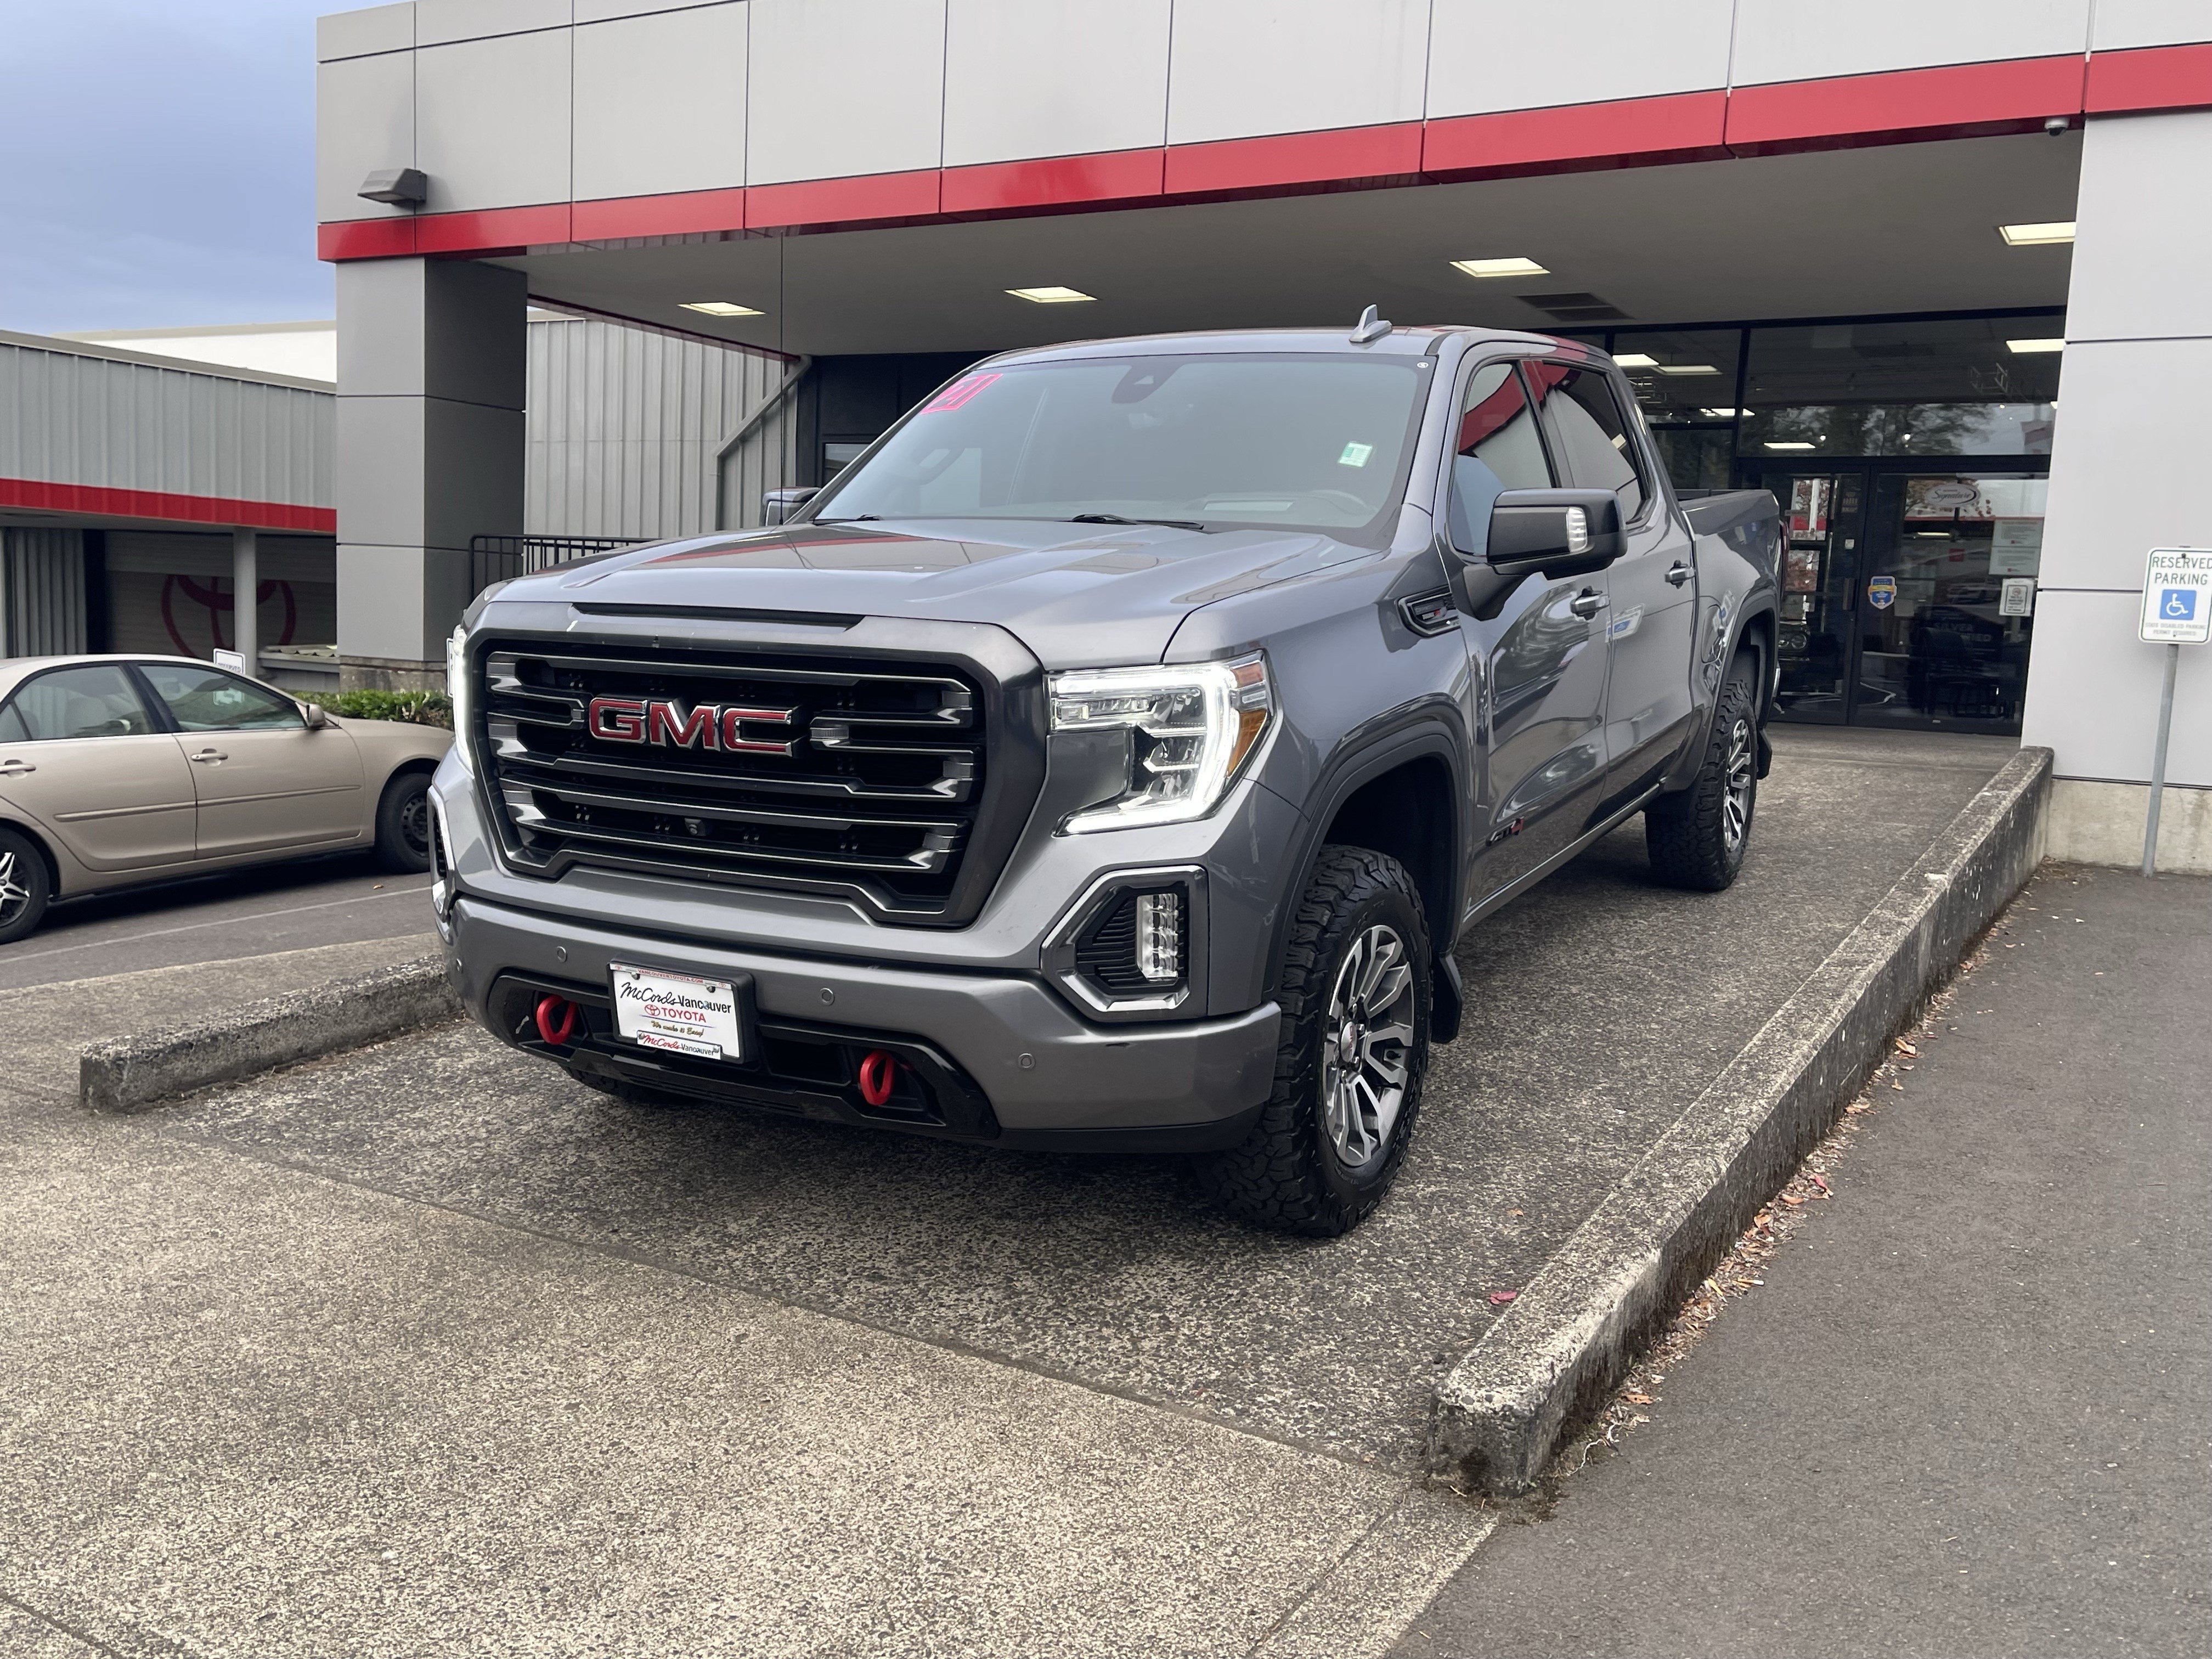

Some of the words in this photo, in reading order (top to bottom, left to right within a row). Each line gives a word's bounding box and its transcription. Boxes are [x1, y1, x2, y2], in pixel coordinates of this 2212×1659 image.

[2152, 556, 2212, 569] RESERVED
[2154, 572, 2208, 585] PARKING
[589, 697, 793, 758] GMC
[637, 969, 704, 983] VANCOUVERTOYOTA.COM
[661, 1007, 707, 1023] TOYOTA
